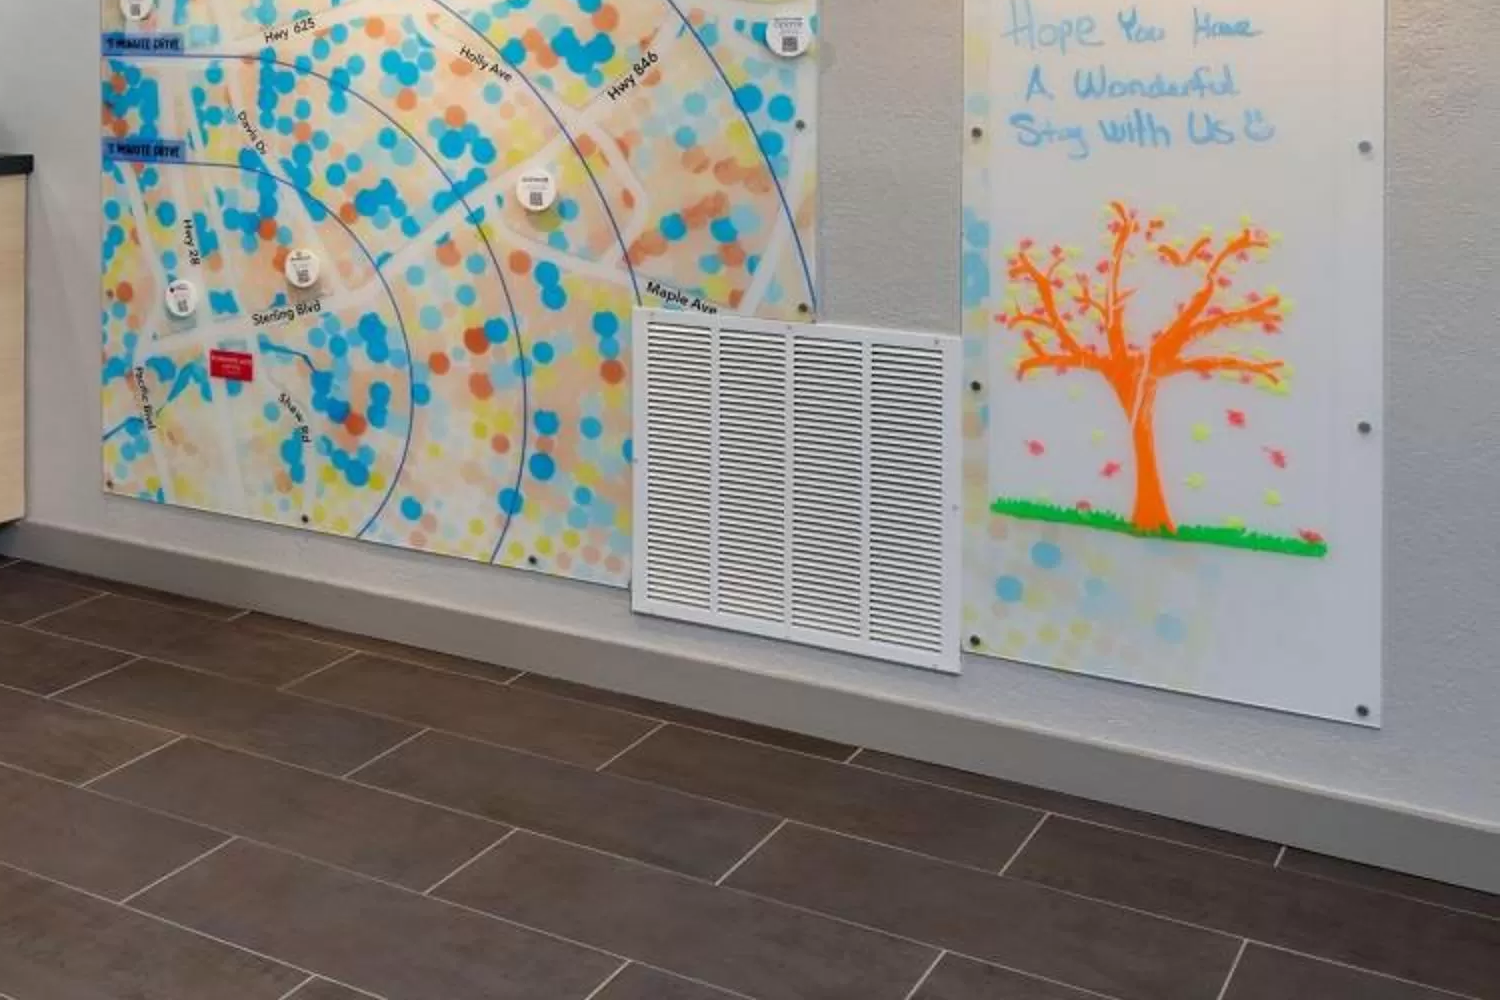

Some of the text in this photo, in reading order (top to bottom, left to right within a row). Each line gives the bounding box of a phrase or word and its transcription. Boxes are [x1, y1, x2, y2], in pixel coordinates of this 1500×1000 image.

[264, 18, 315, 44] Hwy 625
[1117, 6, 1165, 42] You
[460, 47, 512, 82] Holly Ave
[1026, 64, 1239, 101] A Wonderful
[607, 76, 636, 100] Hwy
[237, 111, 268, 156] Davis Dr
[1008, 109, 1235, 160] Stay with Us
[183, 219, 200, 265] Hwy 28
[252, 300, 321, 326] Sterling Blvd
[646, 281, 717, 313] Maple Ave
[277, 392, 311, 444] Shaw Rd
